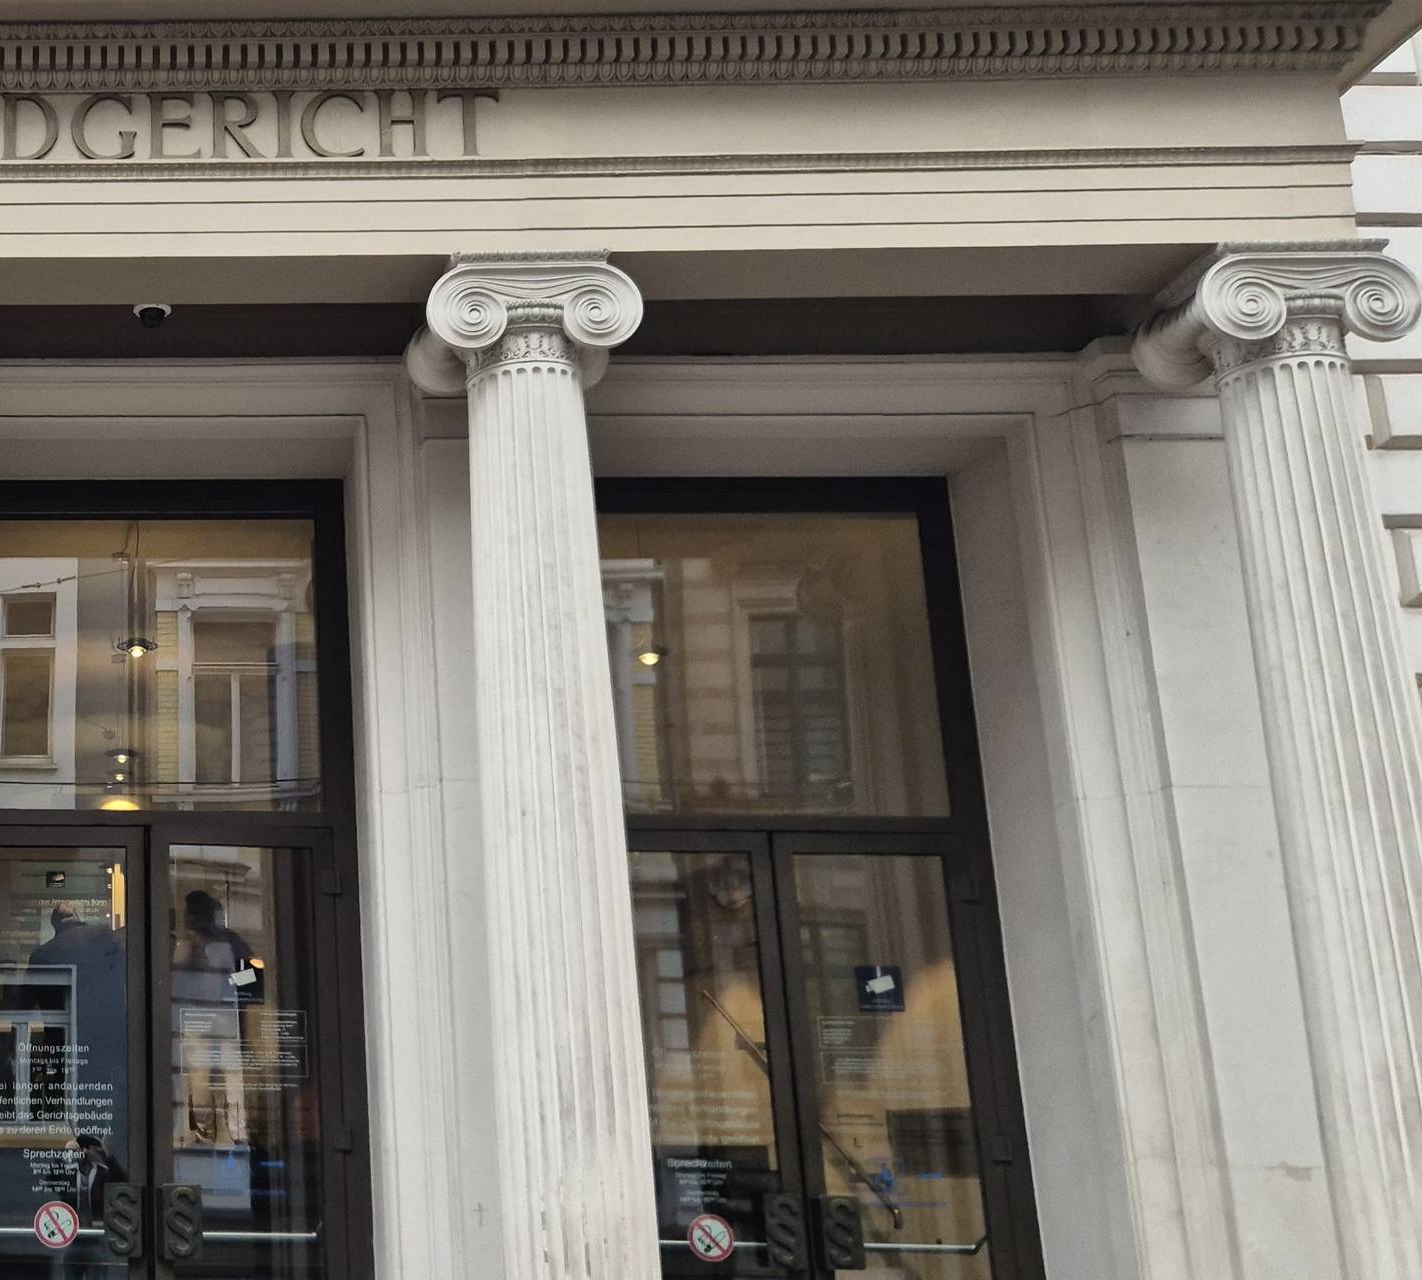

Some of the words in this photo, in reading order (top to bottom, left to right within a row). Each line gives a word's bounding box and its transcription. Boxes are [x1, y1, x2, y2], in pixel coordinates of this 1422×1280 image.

[17, 1041, 90, 1054] Öffnungszeiten
[48, 1081, 114, 1092] andauernden
[44, 1095, 114, 1108] Verhandlungen
[17, 1110, 35, 1120] das
[36, 1110, 114, 1122] Gerichtsgebäude
[6, 1127, 18, 1135] zu
[18, 1125, 46, 1135] deren
[48, 1125, 73, 1135] Ende
[22, 1148, 86, 1161] Sprechzeiten
